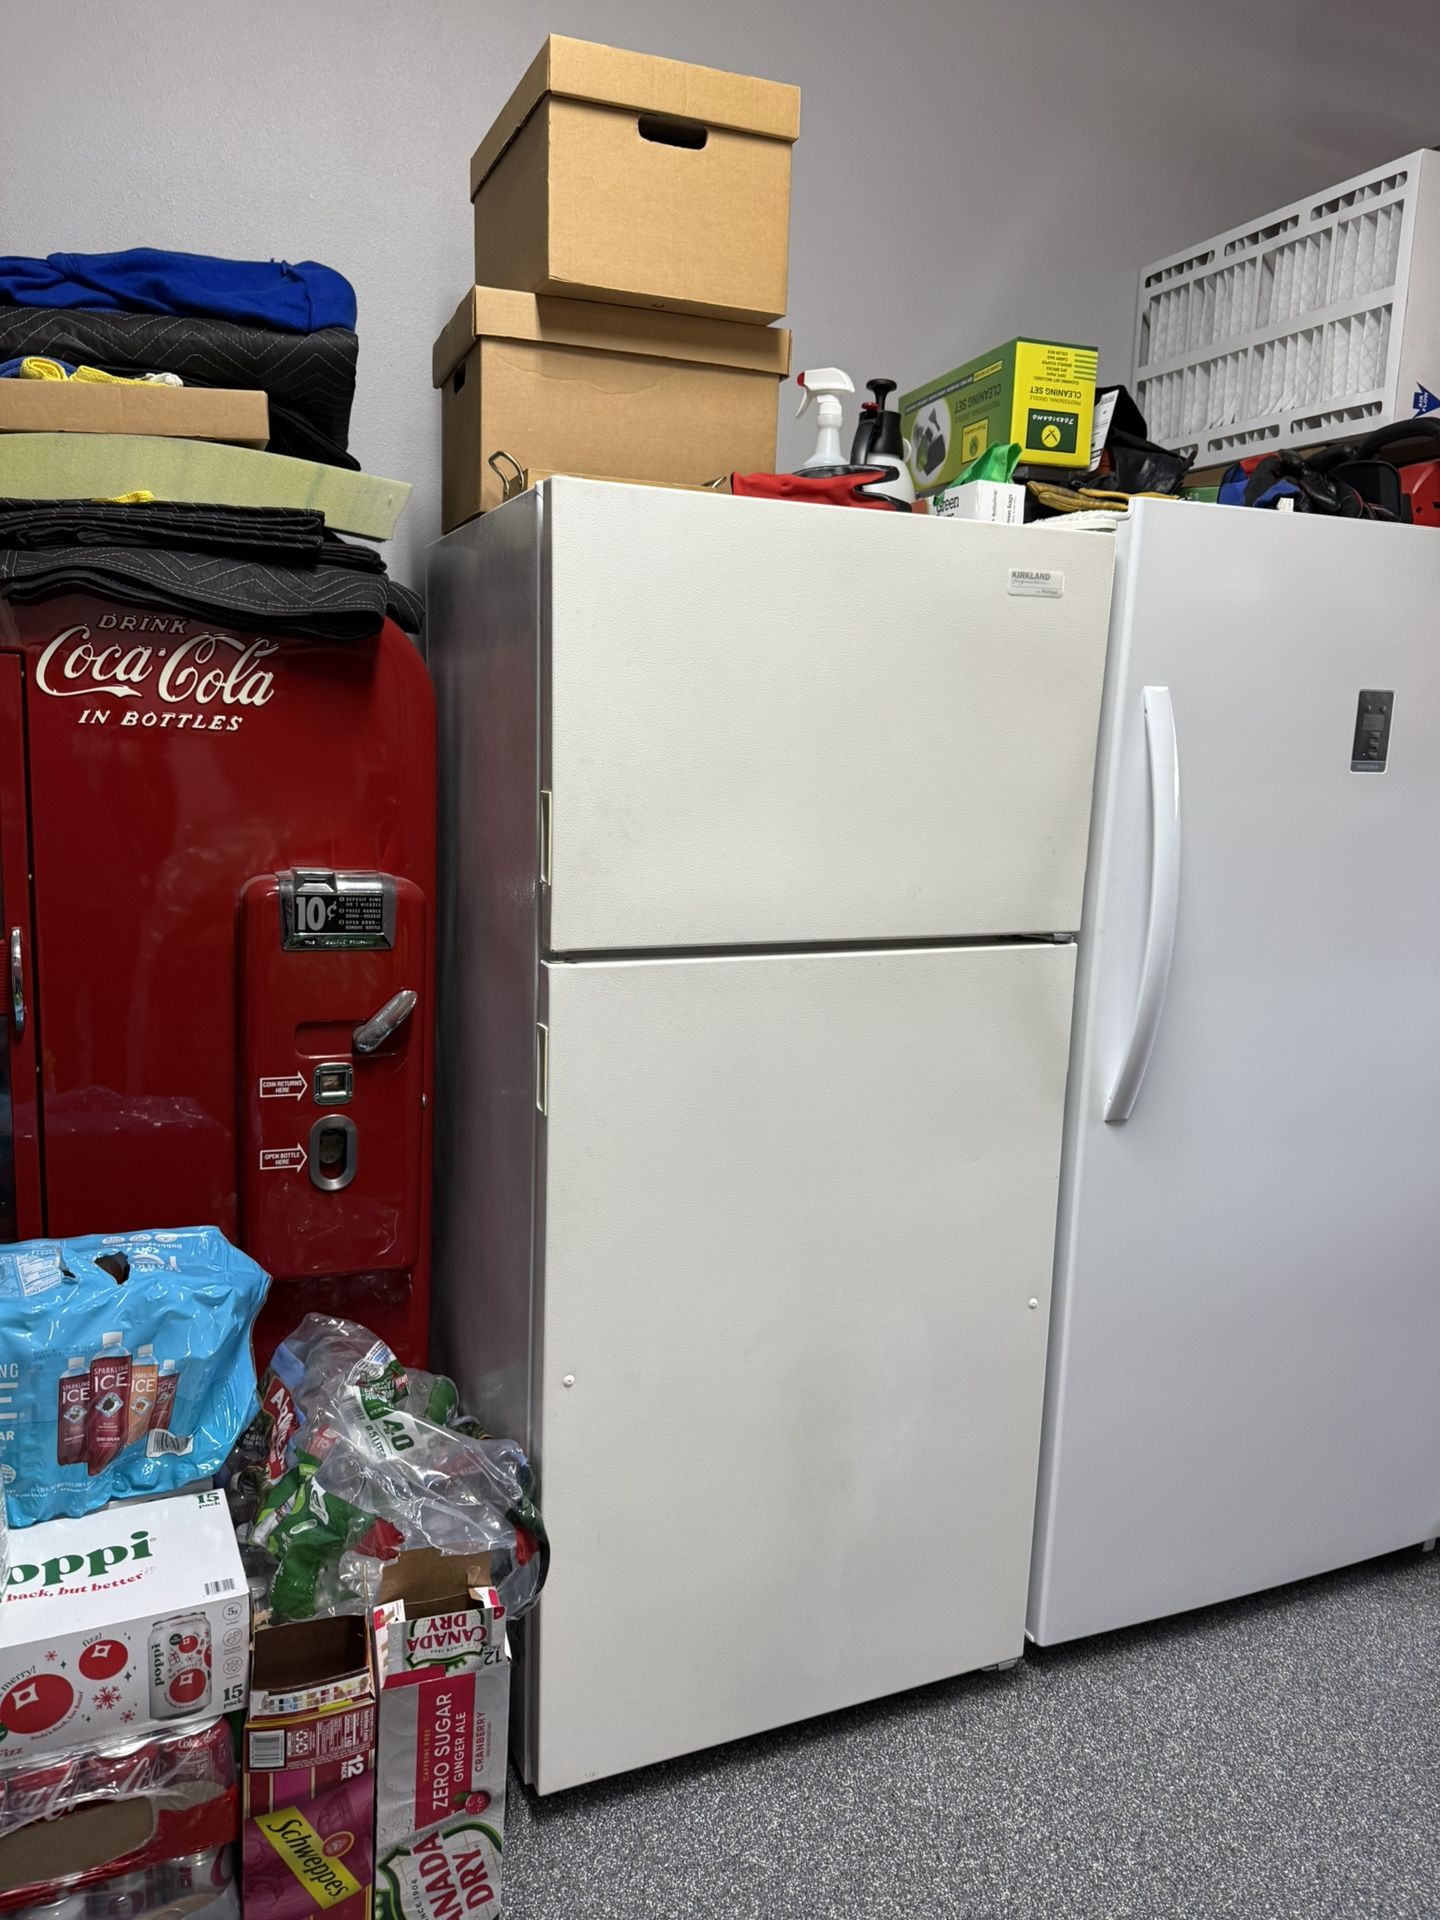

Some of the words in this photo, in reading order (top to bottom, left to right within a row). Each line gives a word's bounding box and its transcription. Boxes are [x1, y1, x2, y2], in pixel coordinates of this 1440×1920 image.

[968, 383, 1002, 408] CLEANING
[1029, 386, 1044, 394] SET
[1045, 387, 1082, 399] CLEANING
[954, 399, 968, 414] SET
[1012, 570, 1051, 581] KIRKLAND
[98, 613, 191, 635] DRINK
[78, 709, 111, 726] IN
[120, 710, 244, 732] BOTTLES
[94, 1364, 129, 1376] SPARKLING
[62, 1380, 90, 1391] SPARKLING
[94, 1372, 128, 1393] ICE
[132, 1379, 156, 1393] ICE
[62, 1387, 90, 1404] ICE
[197, 1492, 220, 1504] 15
[8, 1530, 153, 1587] oppi
[6, 1587, 54, 1603] back,
[58, 1585, 88, 1596] but
[92, 1573, 144, 1592] better
[428, 1613, 466, 1633] DRY
[82, 1632, 102, 1648] fizz!
[406, 1626, 488, 1654] CANADA
[154, 1642, 164, 1687] poppi
[484, 1650, 503, 1666] 12
[1, 1664, 37, 1692] merry!
[223, 1684, 244, 1700] 15
[224, 1698, 244, 1709] pack
[434, 1692, 452, 1754] SUGAR
[454, 1711, 466, 1734] ALE
[475, 1712, 486, 1773] CRANBERRY
[340, 1761, 348, 1780] PACK
[346, 1754, 364, 1779] 12
[454, 1737, 466, 1783] GINGER
[432, 1760, 450, 1811] ZERO
[266, 1818, 350, 1899] Schweppes
[452, 1848, 495, 1911] DRY
